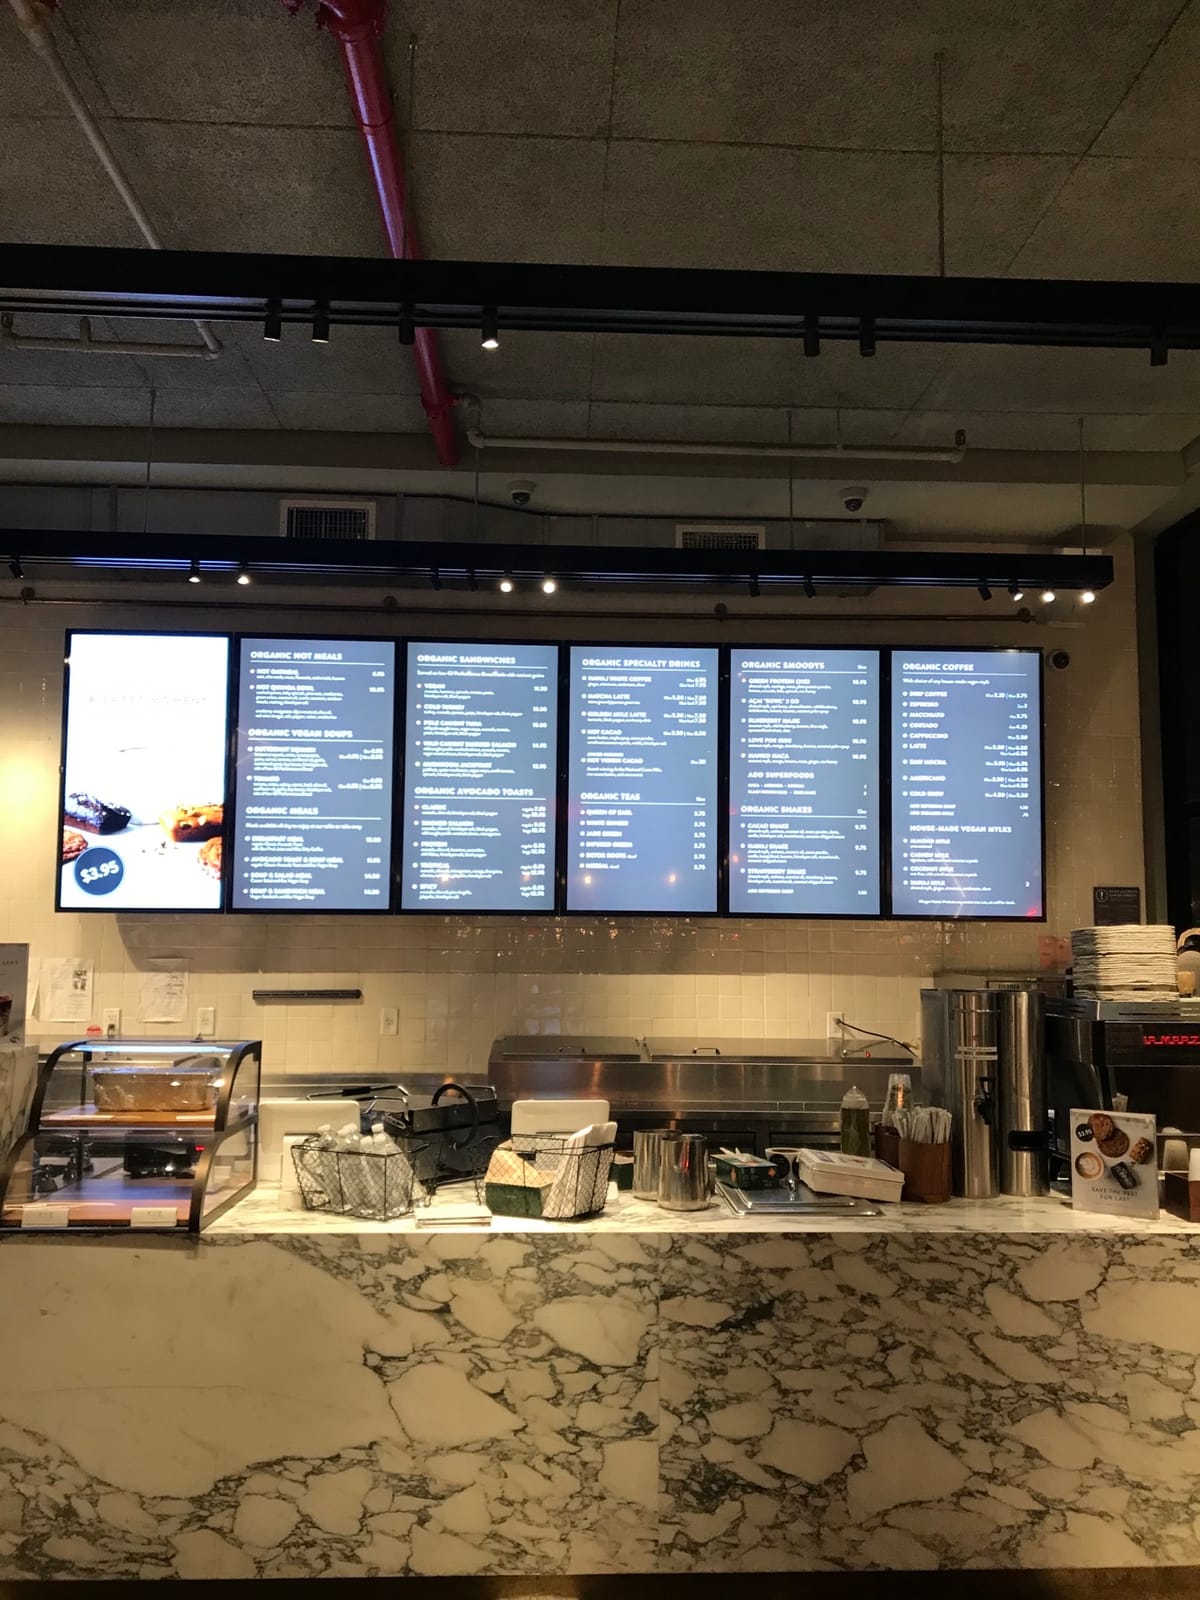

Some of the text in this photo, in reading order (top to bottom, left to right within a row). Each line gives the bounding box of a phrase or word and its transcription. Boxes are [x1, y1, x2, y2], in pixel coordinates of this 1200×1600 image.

[314, 653, 342, 661] MEALS
[417, 655, 516, 664] ORGANIC SANDWICHES
[582, 659, 700, 668] ORGANIC SPECIALTY DRINKS
[741, 661, 825, 670] ORGANIC SMOODYS
[902, 663, 975, 671] ORGANIC COFFEE
[248, 729, 353, 739] ORGANIC VEGAN SOUPS
[415, 787, 534, 796] ORGANIC AVOCADO TOASTS
[580, 792, 619, 800] ORGANIC
[289, 808, 319, 816] MEALS
[781, 806, 813, 814] SHAKES
[910, 825, 959, 833] HOUSE-MADE
[80, 860, 119, 884] $3.95
